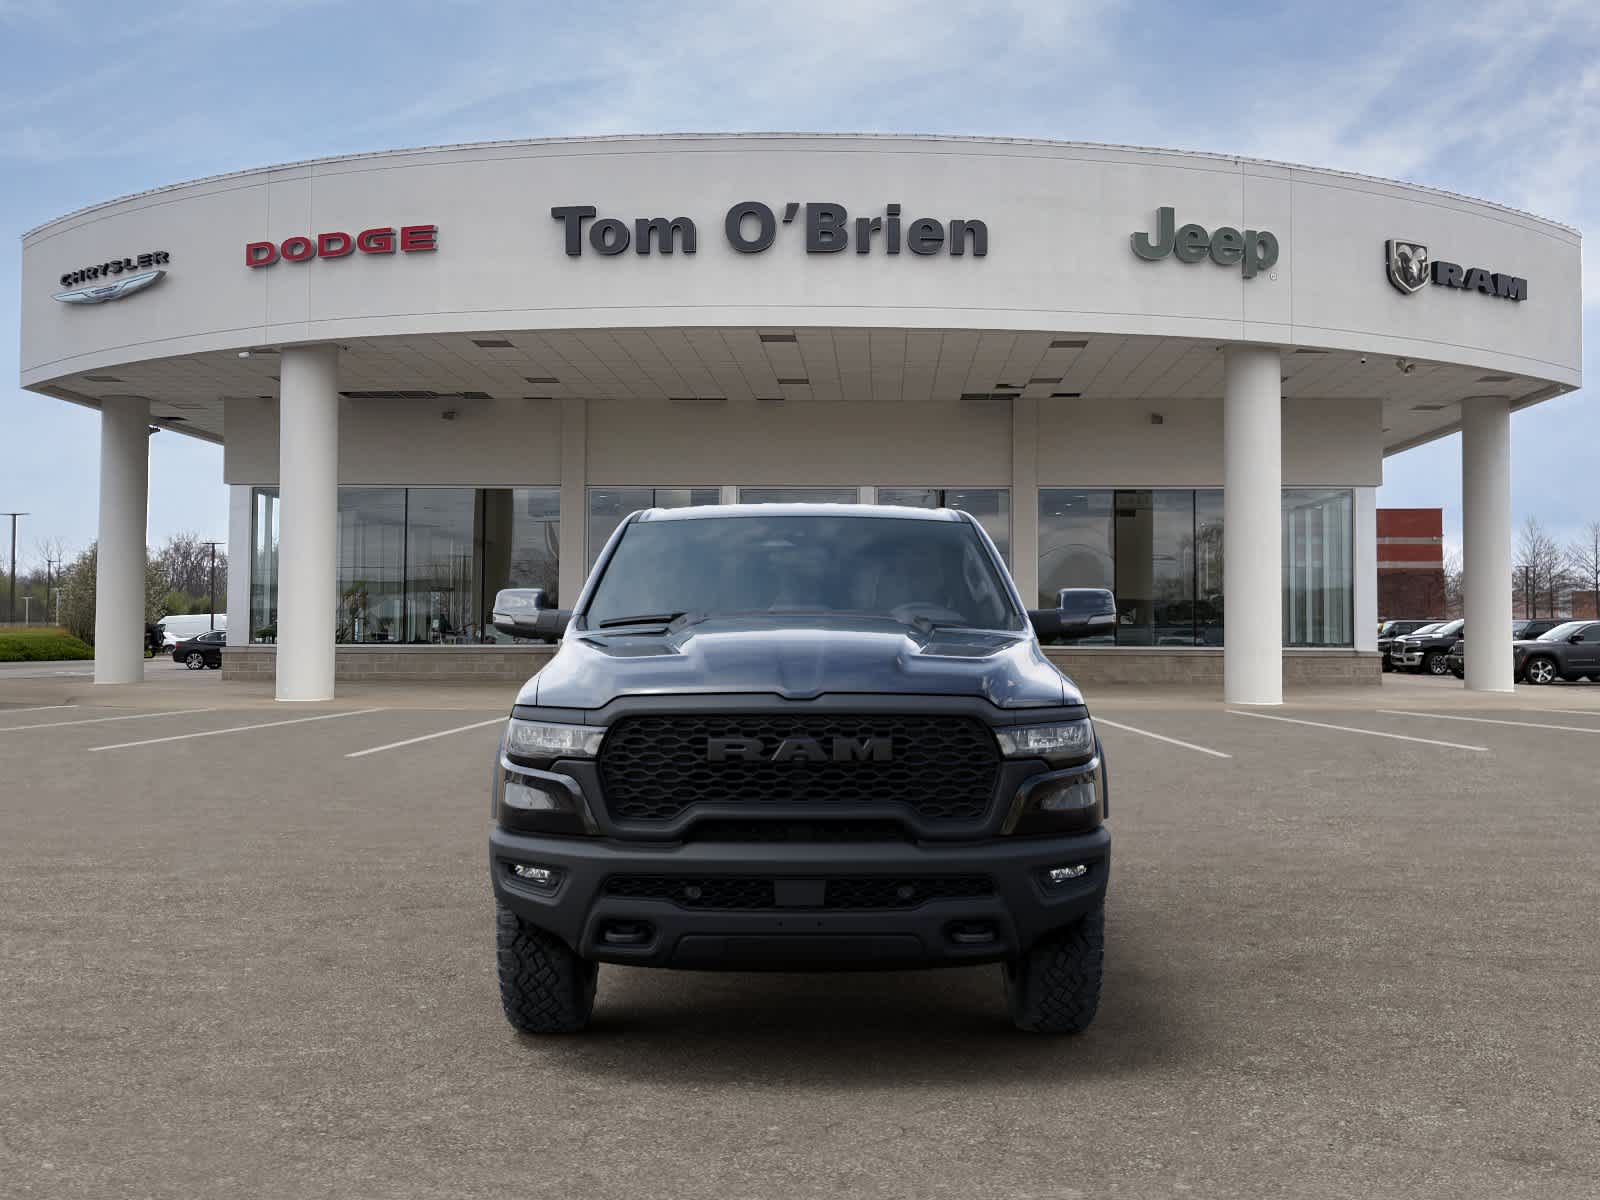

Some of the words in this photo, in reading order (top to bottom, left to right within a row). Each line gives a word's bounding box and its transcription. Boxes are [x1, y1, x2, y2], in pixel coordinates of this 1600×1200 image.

[245, 225, 438, 268] DODGE
[551, 205, 696, 256] Tom
[725, 202, 988, 256] O'Brien
[60, 250, 170, 287] CHRYSLER
[1431, 260, 1528, 301] RAM
[706, 736, 895, 762] RAM
